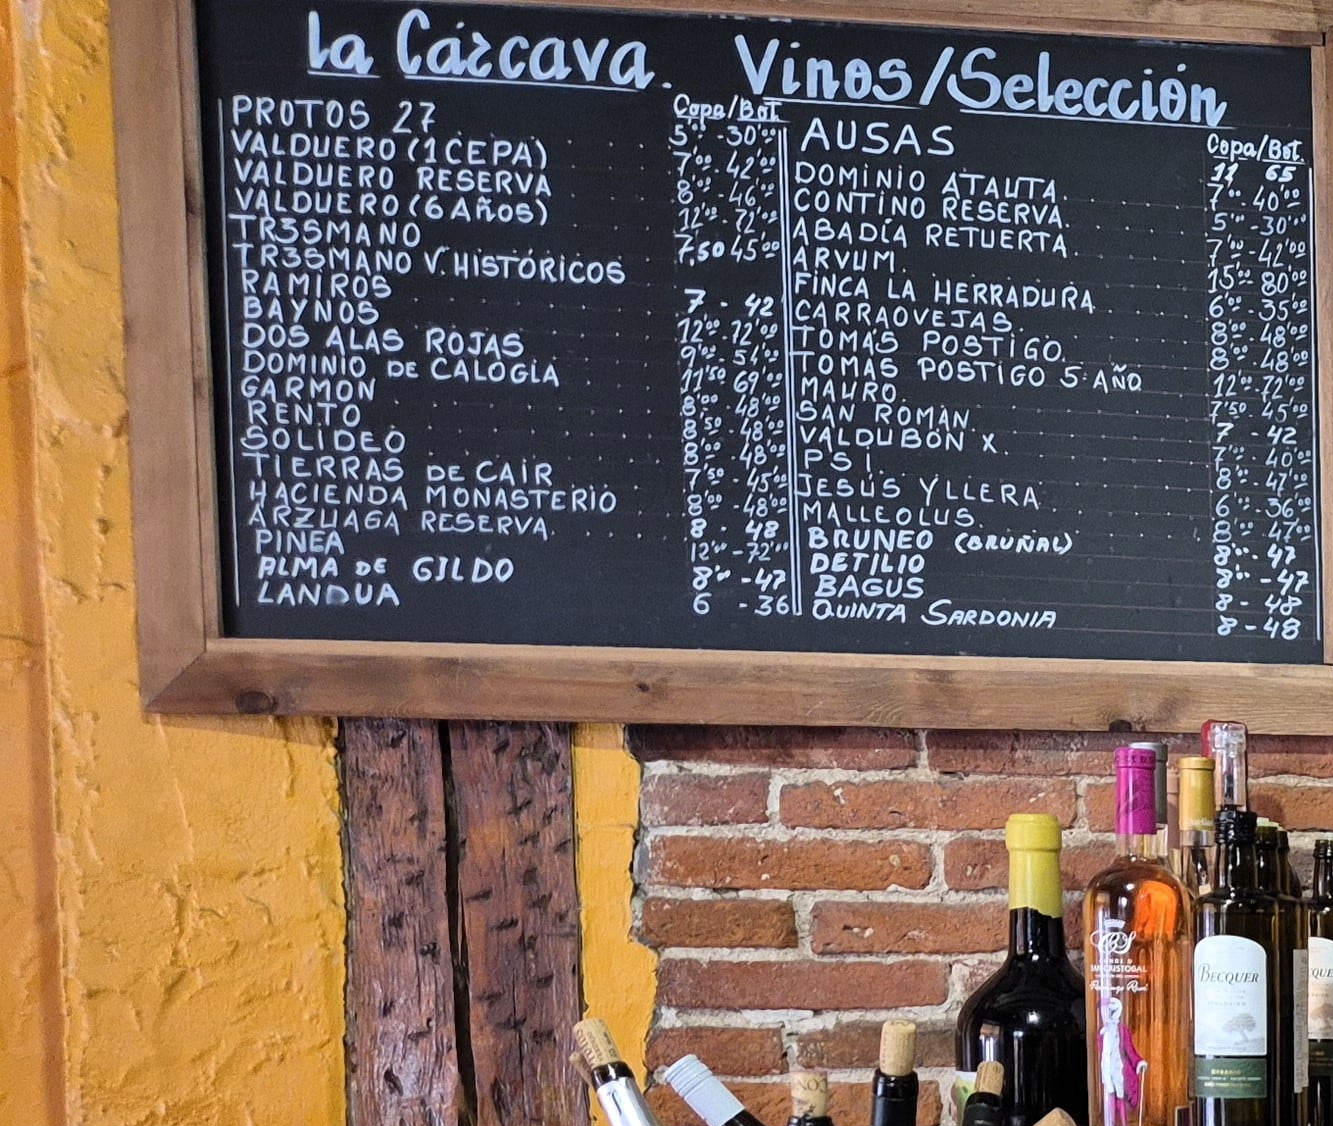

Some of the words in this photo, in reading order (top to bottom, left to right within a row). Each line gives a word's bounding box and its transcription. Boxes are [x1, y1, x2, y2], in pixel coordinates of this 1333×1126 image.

[230, 95, 370, 131] PROTOS
[392, 101, 436, 132] 27
[230, 128, 396, 161] VALDUERO
[800, 119, 955, 156] AUSAS
[234, 160, 394, 189] VALDUERO
[418, 166, 551, 196] RESERVA
[795, 161, 926, 191] DOMINIO
[943, 167, 1057, 200] ATAUTA
[234, 189, 400, 216] VALDUERO
[794, 190, 926, 218] CONTINO
[943, 196, 1061, 225] RESERVA
[229, 214, 422, 246] TR3SMANO
[927, 224, 1069, 257] RETUERTA
[229, 242, 412, 276] TR3SMANO
[793, 248, 894, 272] ARVUM
[243, 270, 393, 299] RAMIROS
[795, 272, 869, 298] FINCA
[887, 274, 916, 301] LA
[935, 278, 1094, 310] HERRADURA
[244, 298, 379, 324] BAYNOS
[795, 299, 1013, 332] CARRAOVEJAS
[243, 323, 309, 349] DOS
[326, 324, 403, 353] ALAS
[427, 328, 523, 356] ROJAS
[922, 329, 1063, 359] POSTIGO
[243, 351, 367, 378] DOMINIO
[388, 359, 418, 377] DE
[919, 356, 1044, 387] POSTIGO
[801, 377, 897, 403] MAURO
[248, 401, 361, 426] RENTO
[797, 403, 853, 423] SAN
[241, 425, 406, 451] SOLIDEO
[982, 433, 997, 454] X
[241, 453, 403, 480] TIERRAS
[428, 464, 465, 483] DE
[476, 460, 553, 485] CAIR
[248, 482, 407, 508] HACIENDA
[427, 483, 616, 512] MONASTERIO
[920, 474, 1040, 508] YLLERA
[248, 508, 400, 533] ARZUAGA
[422, 512, 549, 540] RESERVA
[803, 501, 976, 528] MALLEOLUS
[256, 531, 344, 554] PINEA
[808, 527, 933, 551] BRUNEO
[258, 557, 338, 578] ALMA
[356, 559, 386, 576] DE
[413, 558, 514, 582] GILDO
[258, 582, 400, 606] LANDUA
[814, 576, 924, 599] BAGUS
[812, 599, 906, 622] QUINTA
[921, 599, 1057, 628] SARDONIA
